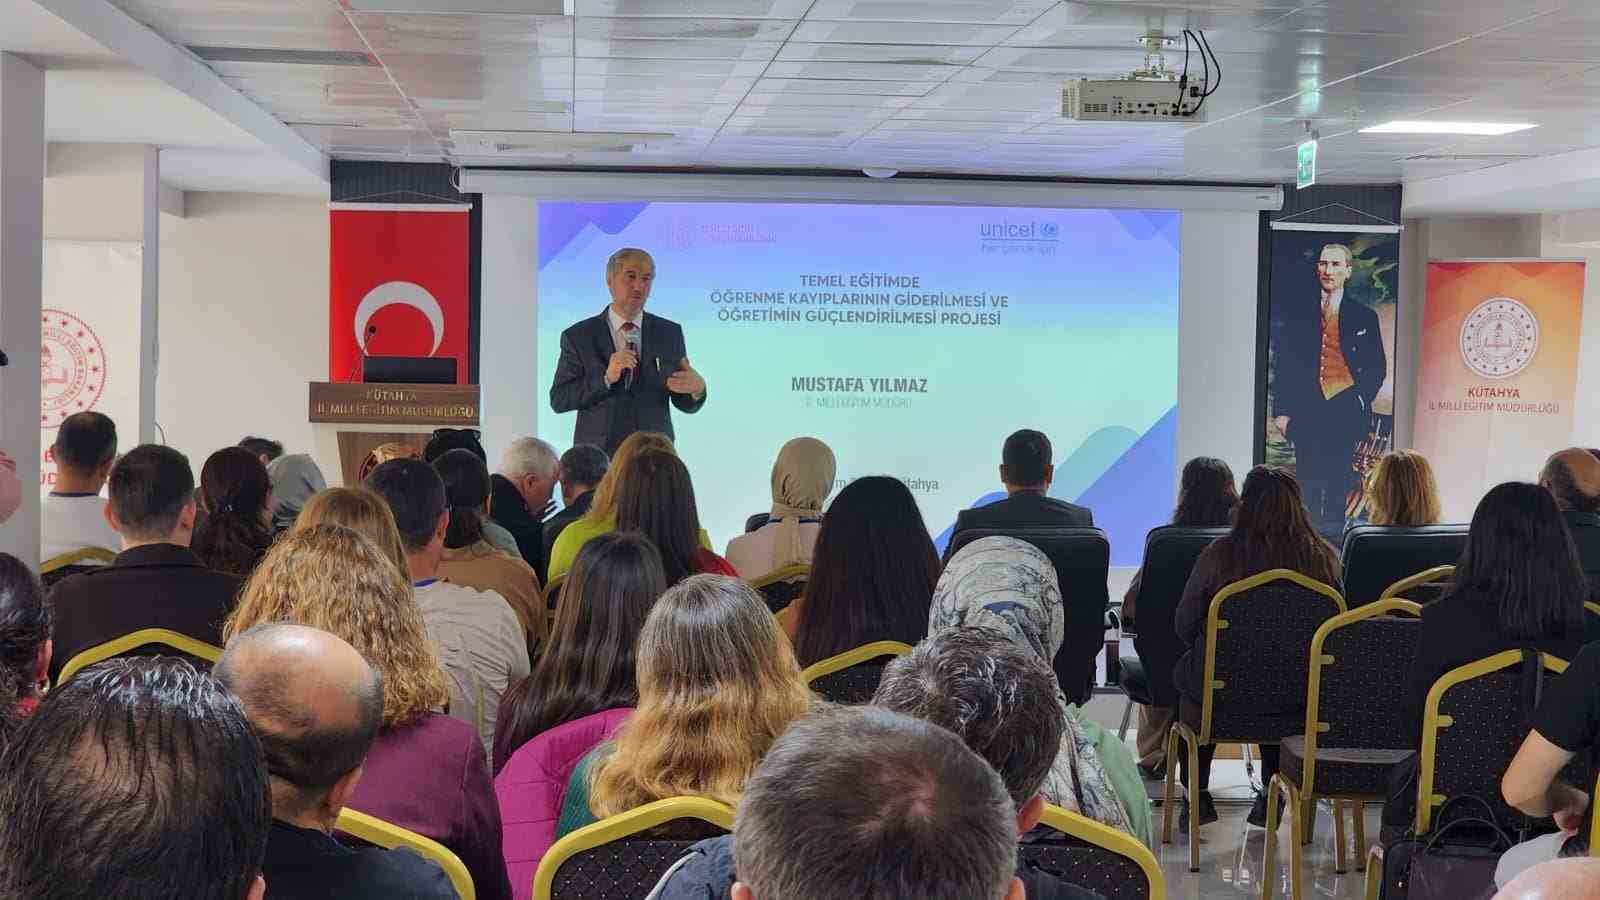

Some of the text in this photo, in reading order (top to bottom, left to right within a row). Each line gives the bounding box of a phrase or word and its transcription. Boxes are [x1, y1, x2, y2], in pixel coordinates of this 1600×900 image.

[980, 221, 1034, 238] unicef
[800, 272, 920, 288] TEMEL EĞİTİMDE
[710, 288, 1009, 308] ÖĞRENME KAYIPLARININ GİDERİLMESİ VE
[718, 306, 1001, 326] ÖĞRETİMİN GÜÇLENDİRİLMESİ PROJESİ
[791, 376, 928, 393] MUSTAFA YILMAZ
[1468, 385, 1520, 399] KÜTAHYA
[366, 388, 416, 401] KÜTAHYA
